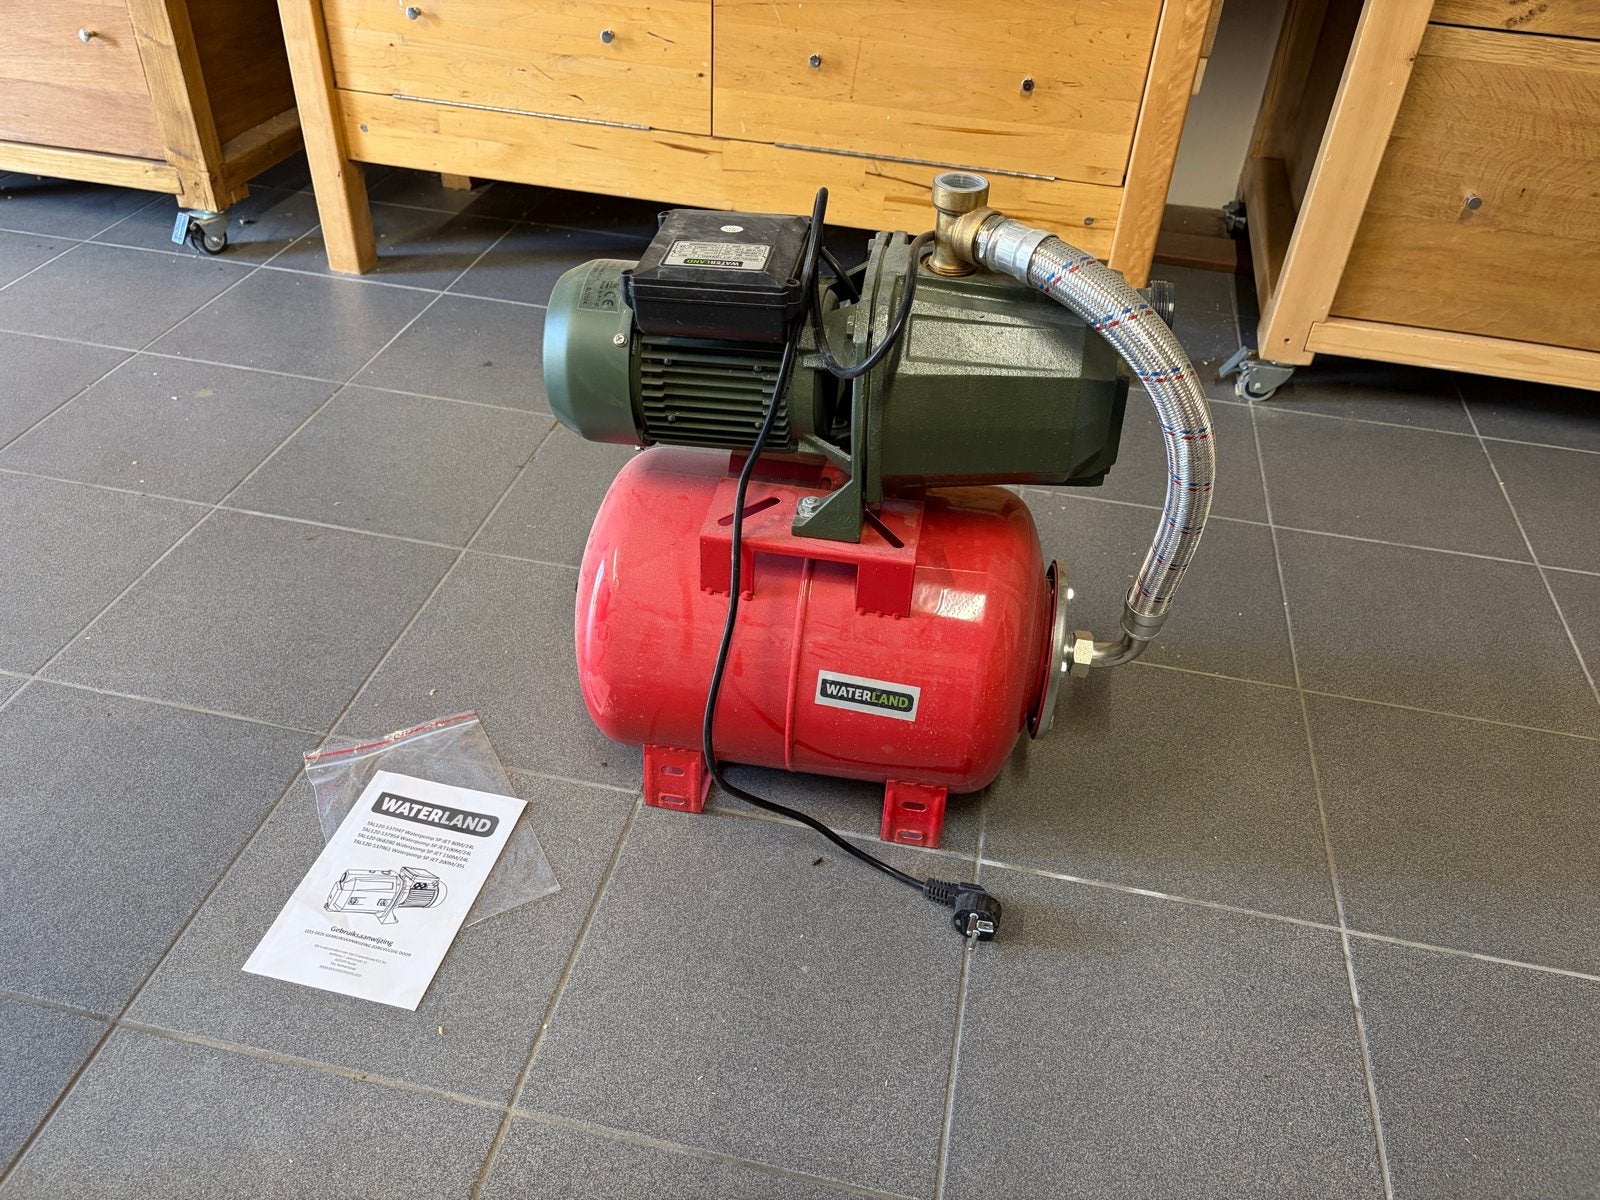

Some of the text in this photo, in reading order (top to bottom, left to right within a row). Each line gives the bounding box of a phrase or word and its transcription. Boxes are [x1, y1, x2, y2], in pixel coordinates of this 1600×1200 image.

[825, 683, 909, 709] WATERLAND
[381, 796, 492, 833] WATERLAND
[400, 835, 430, 847] Waterpomp
[405, 829, 435, 841] Waterpomp
[391, 847, 422, 860] Waterpomp
[395, 841, 426, 853] Waterpomp
[325, 933, 372, 948] GEBRUIKSAANWIJZING
[330, 925, 394, 947] Gebruiksaanwijzing
